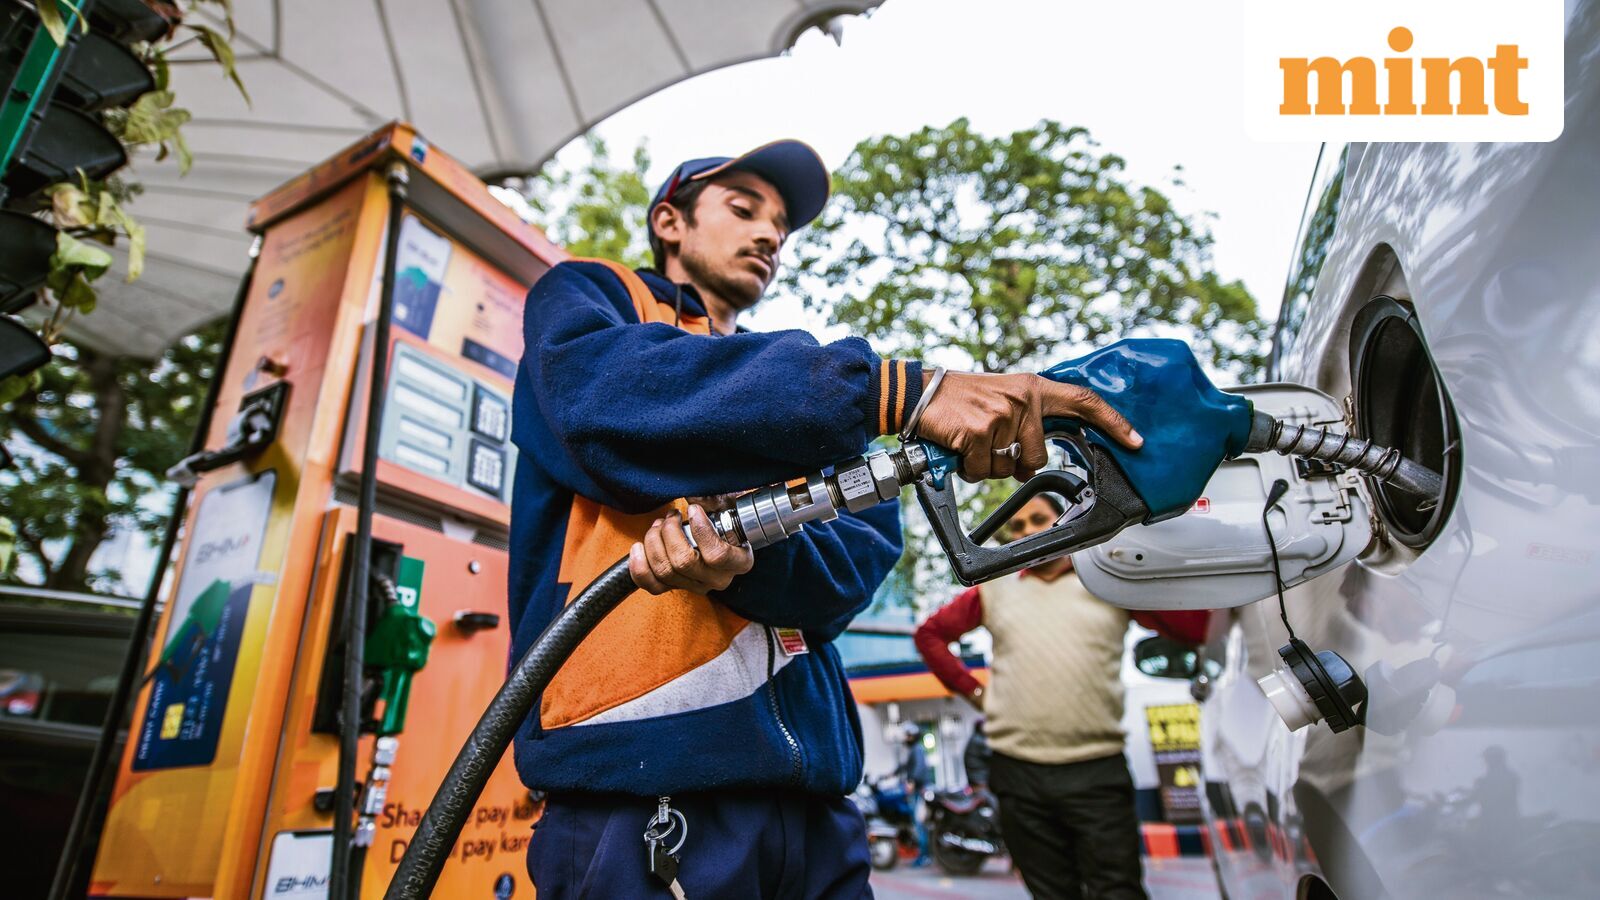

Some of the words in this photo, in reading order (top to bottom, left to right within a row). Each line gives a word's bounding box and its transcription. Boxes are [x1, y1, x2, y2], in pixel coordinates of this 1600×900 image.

[476, 806, 510, 830] pay
[462, 838, 497, 864] pay
[408, 857, 433, 887] TYPE
